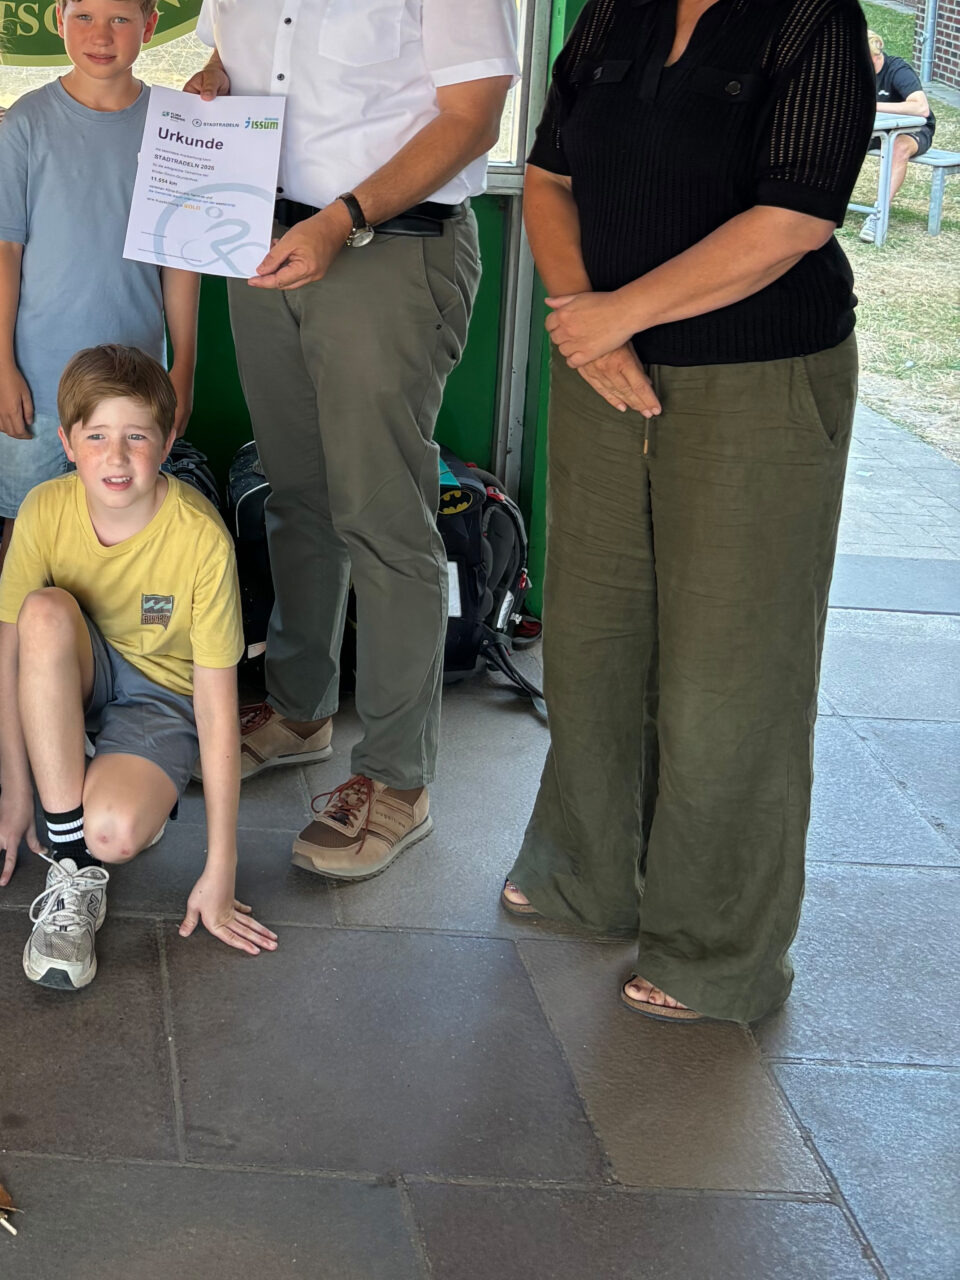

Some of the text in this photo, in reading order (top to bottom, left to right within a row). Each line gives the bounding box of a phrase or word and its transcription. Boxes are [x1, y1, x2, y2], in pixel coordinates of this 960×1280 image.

[251, 121, 279, 130] issum
[158, 127, 224, 150] Urkunde
[154, 154, 200, 168] STADTRADELN
